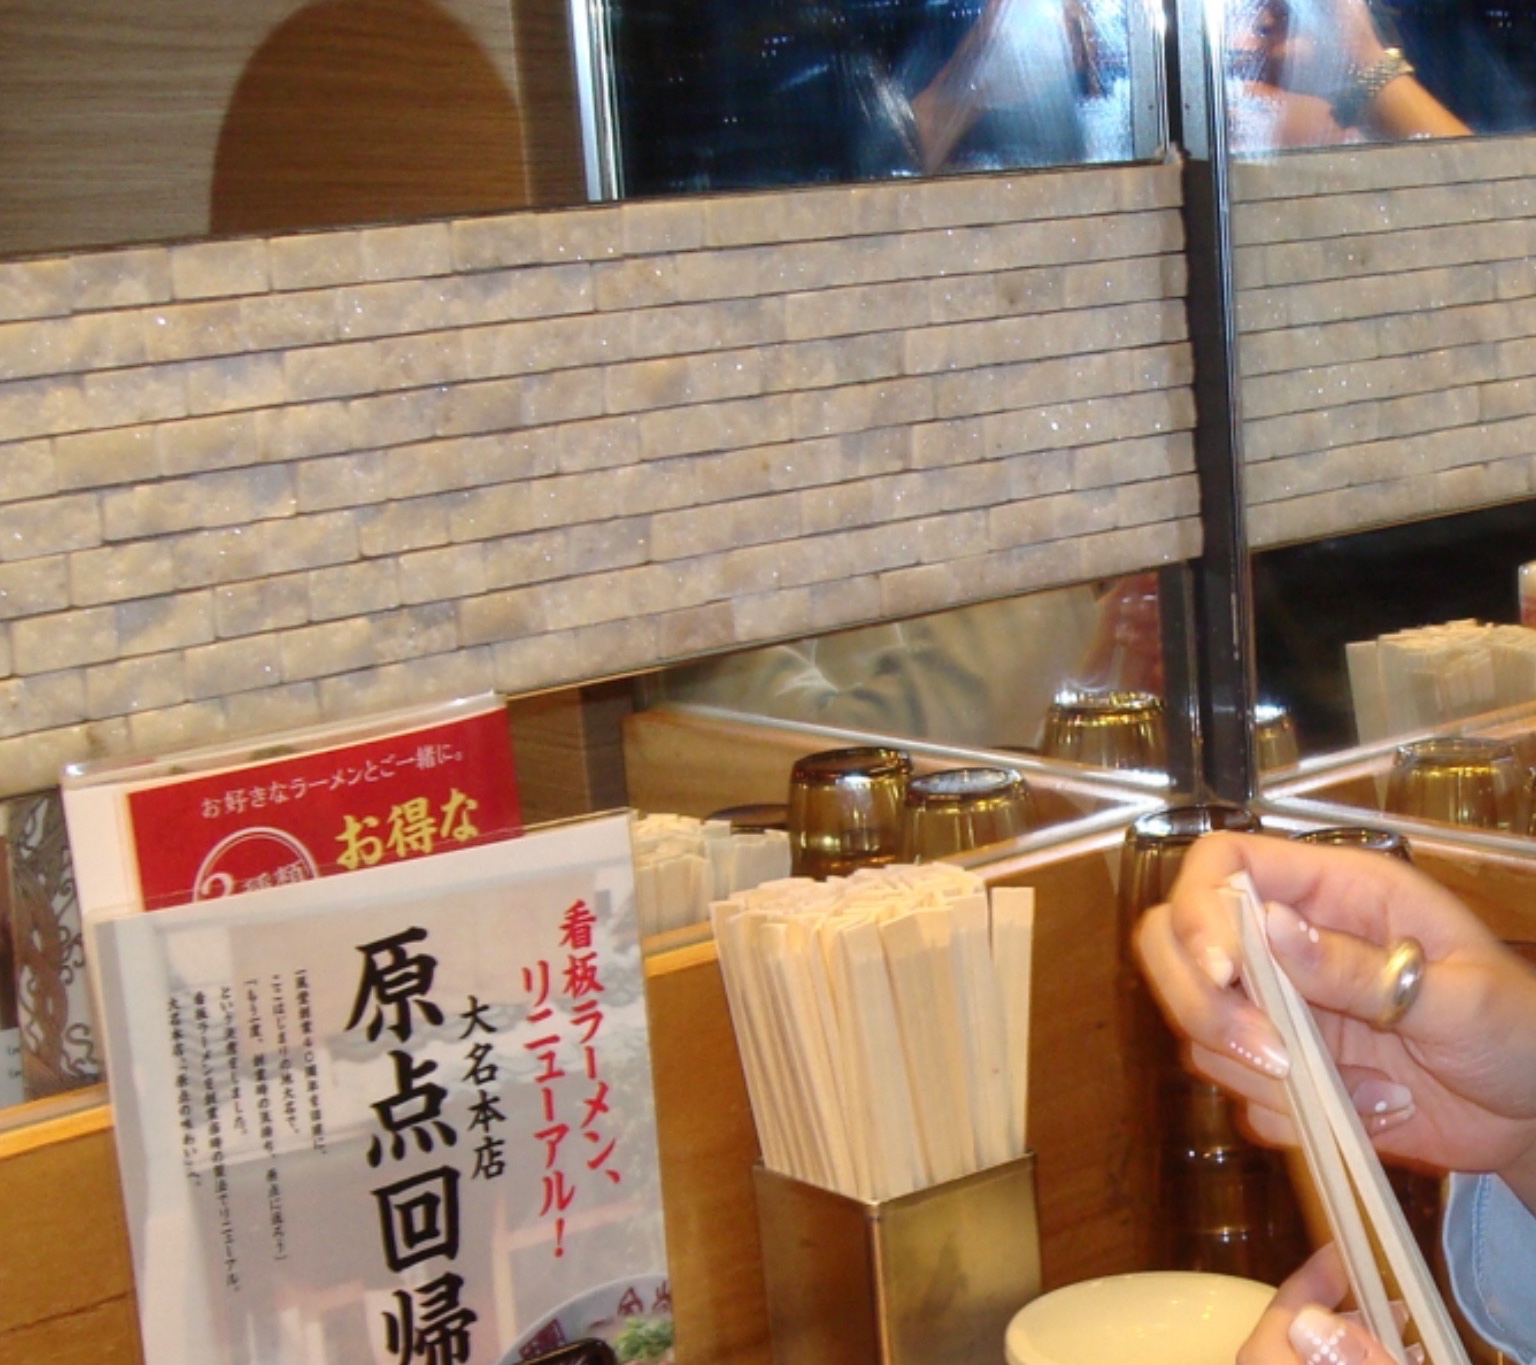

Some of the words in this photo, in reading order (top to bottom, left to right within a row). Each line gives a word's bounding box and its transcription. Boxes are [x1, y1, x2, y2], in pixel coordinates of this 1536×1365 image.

[201, 743, 463, 819] お好きなラーメンとご一緒に。
[334, 787, 480, 870] お得な
[459, 995, 507, 1181] 大名本店
[522, 960, 576, 1258] リニューアル！
[559, 899, 621, 1184] 看板ラーメン、
